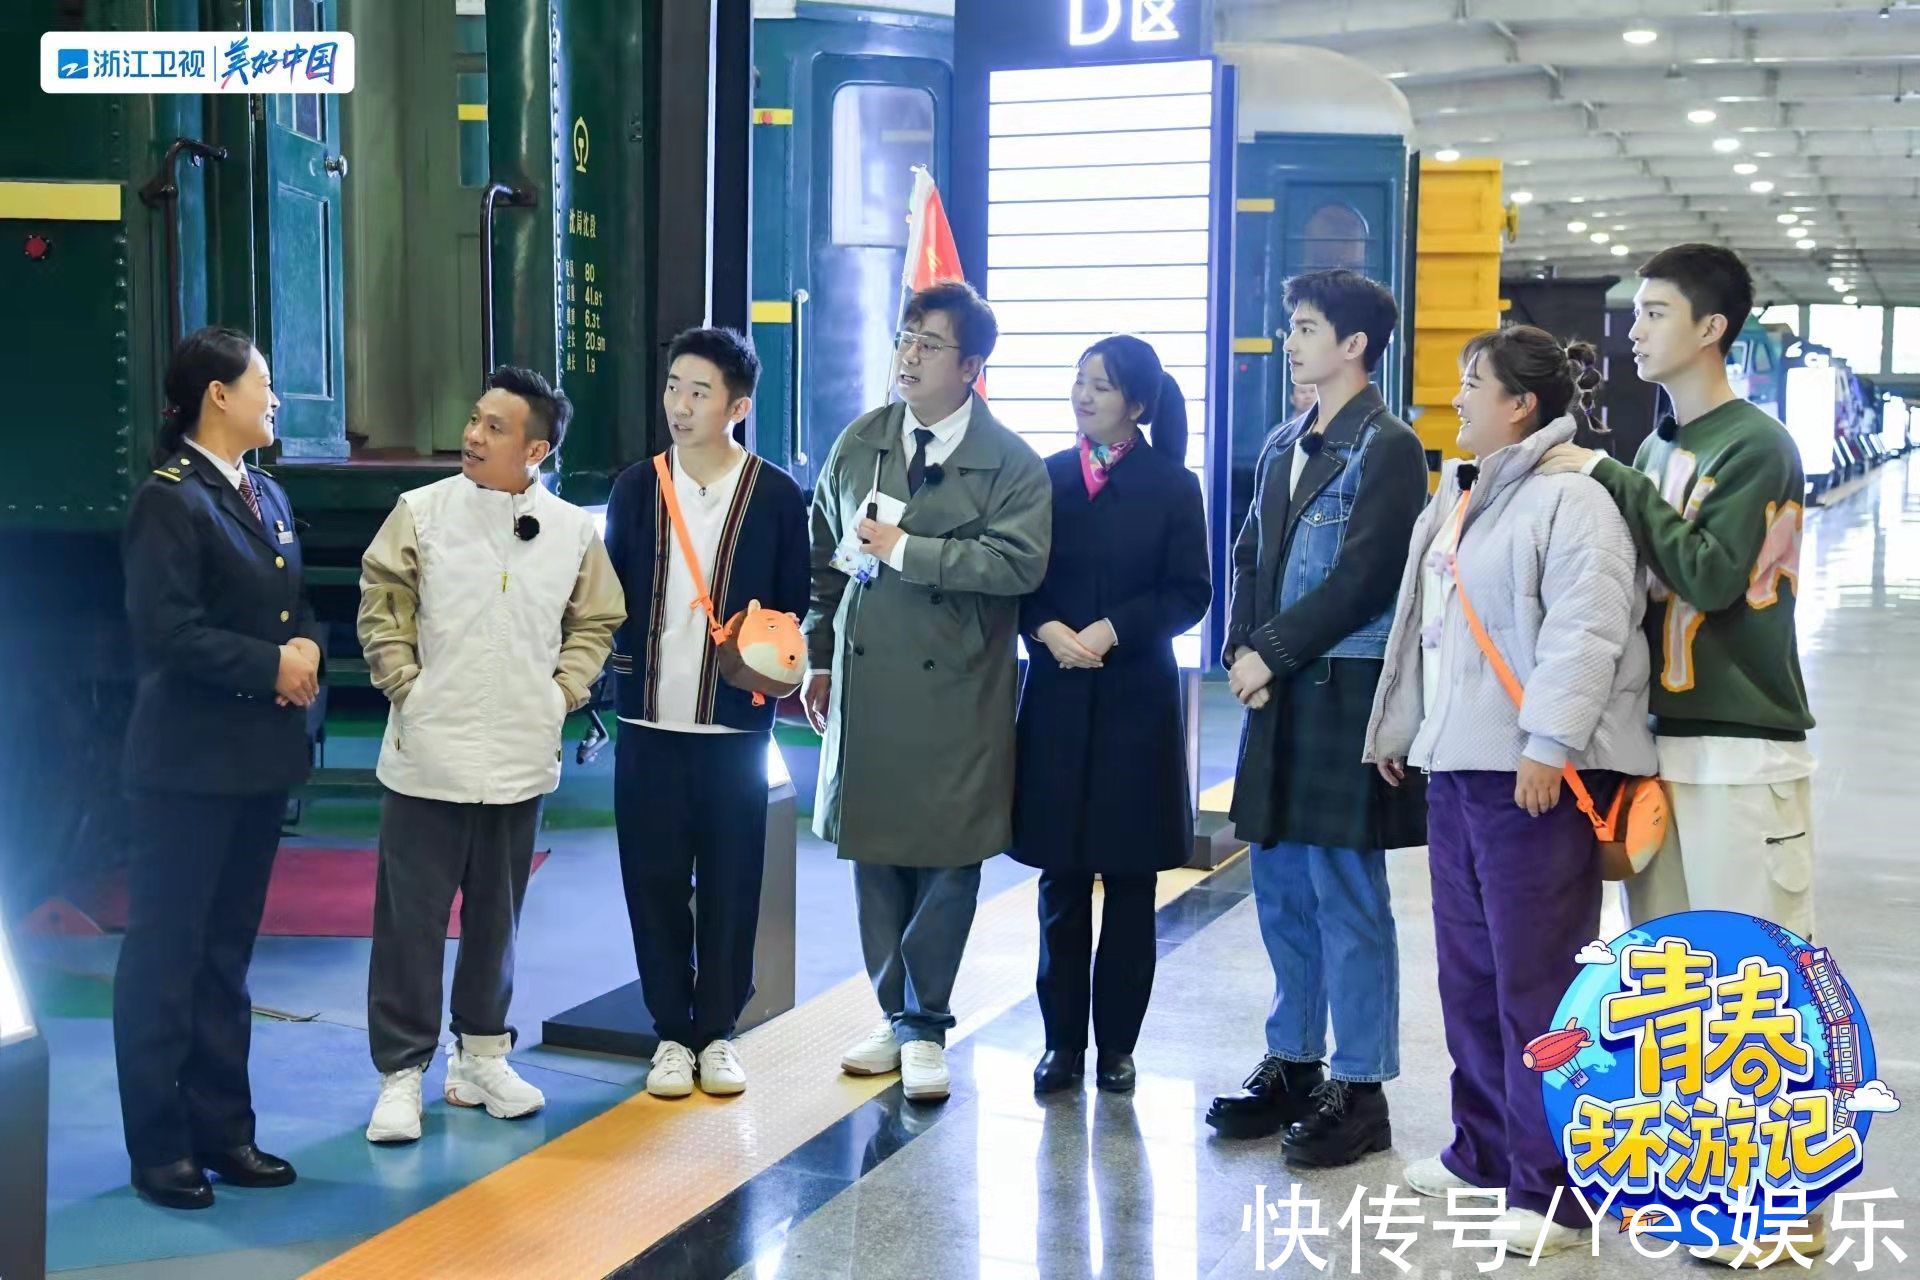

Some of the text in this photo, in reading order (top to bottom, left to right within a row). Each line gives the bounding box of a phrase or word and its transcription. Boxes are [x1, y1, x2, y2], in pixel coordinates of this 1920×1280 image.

[1069, 0, 1180, 46] D区
[584, 262, 595, 282] 80
[584, 309, 601, 329] 6.3t
